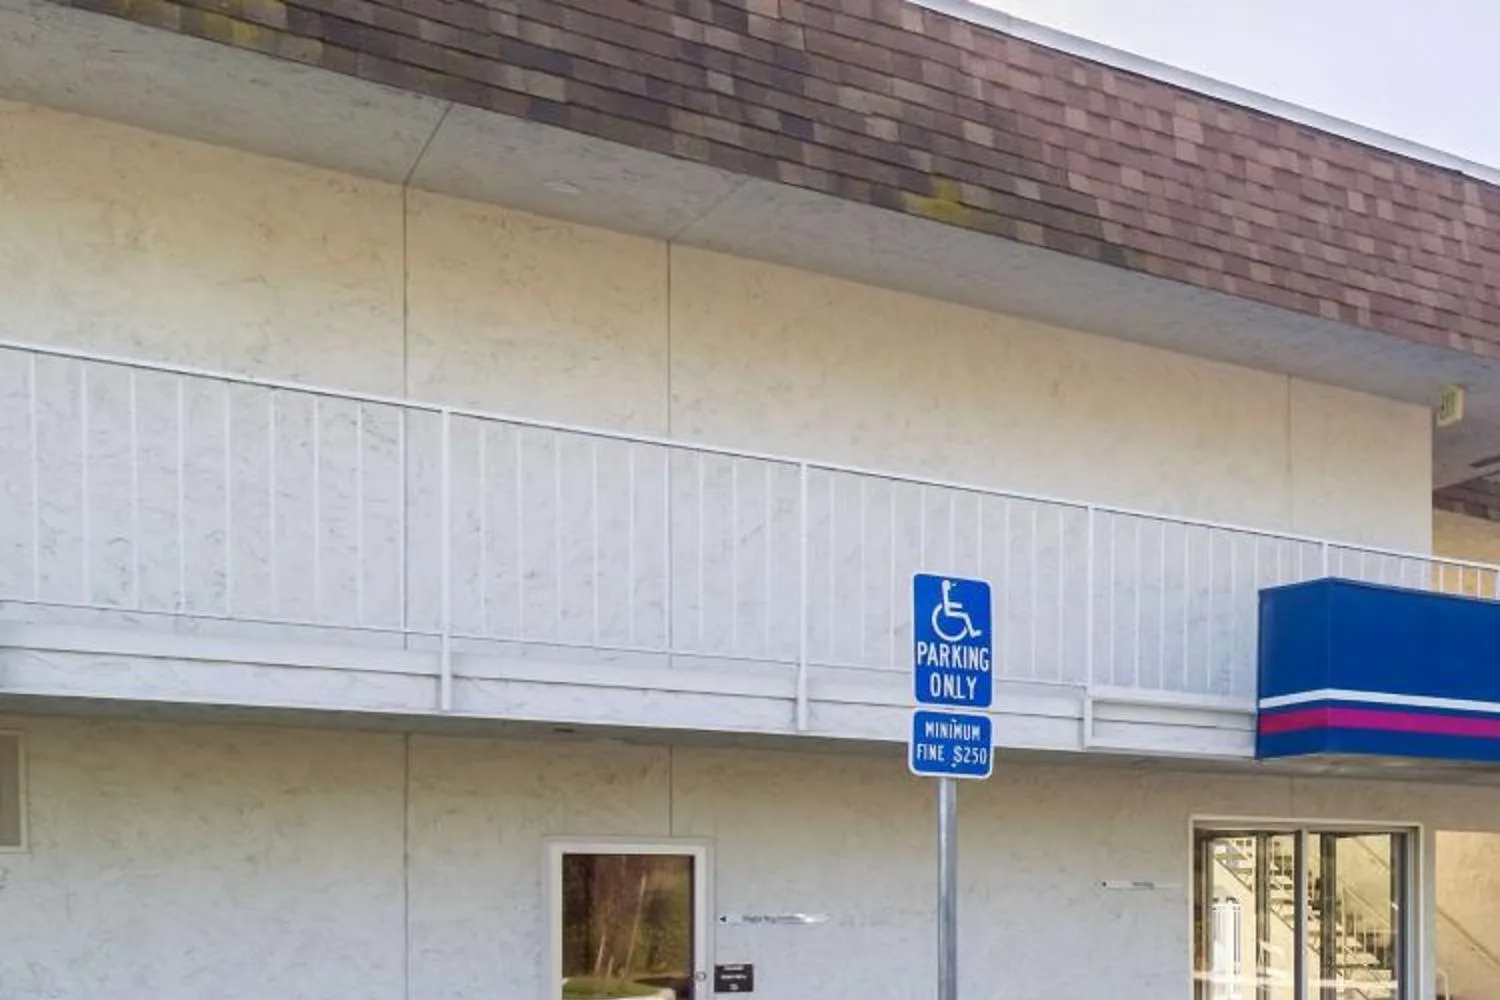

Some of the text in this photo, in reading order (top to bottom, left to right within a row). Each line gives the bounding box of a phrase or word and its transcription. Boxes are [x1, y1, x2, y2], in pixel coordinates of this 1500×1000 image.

[916, 640, 990, 672] PARKING
[929, 672, 977, 700] ONLY
[925, 721, 981, 741] MINIMUM
[916, 743, 987, 765] FINE $250
